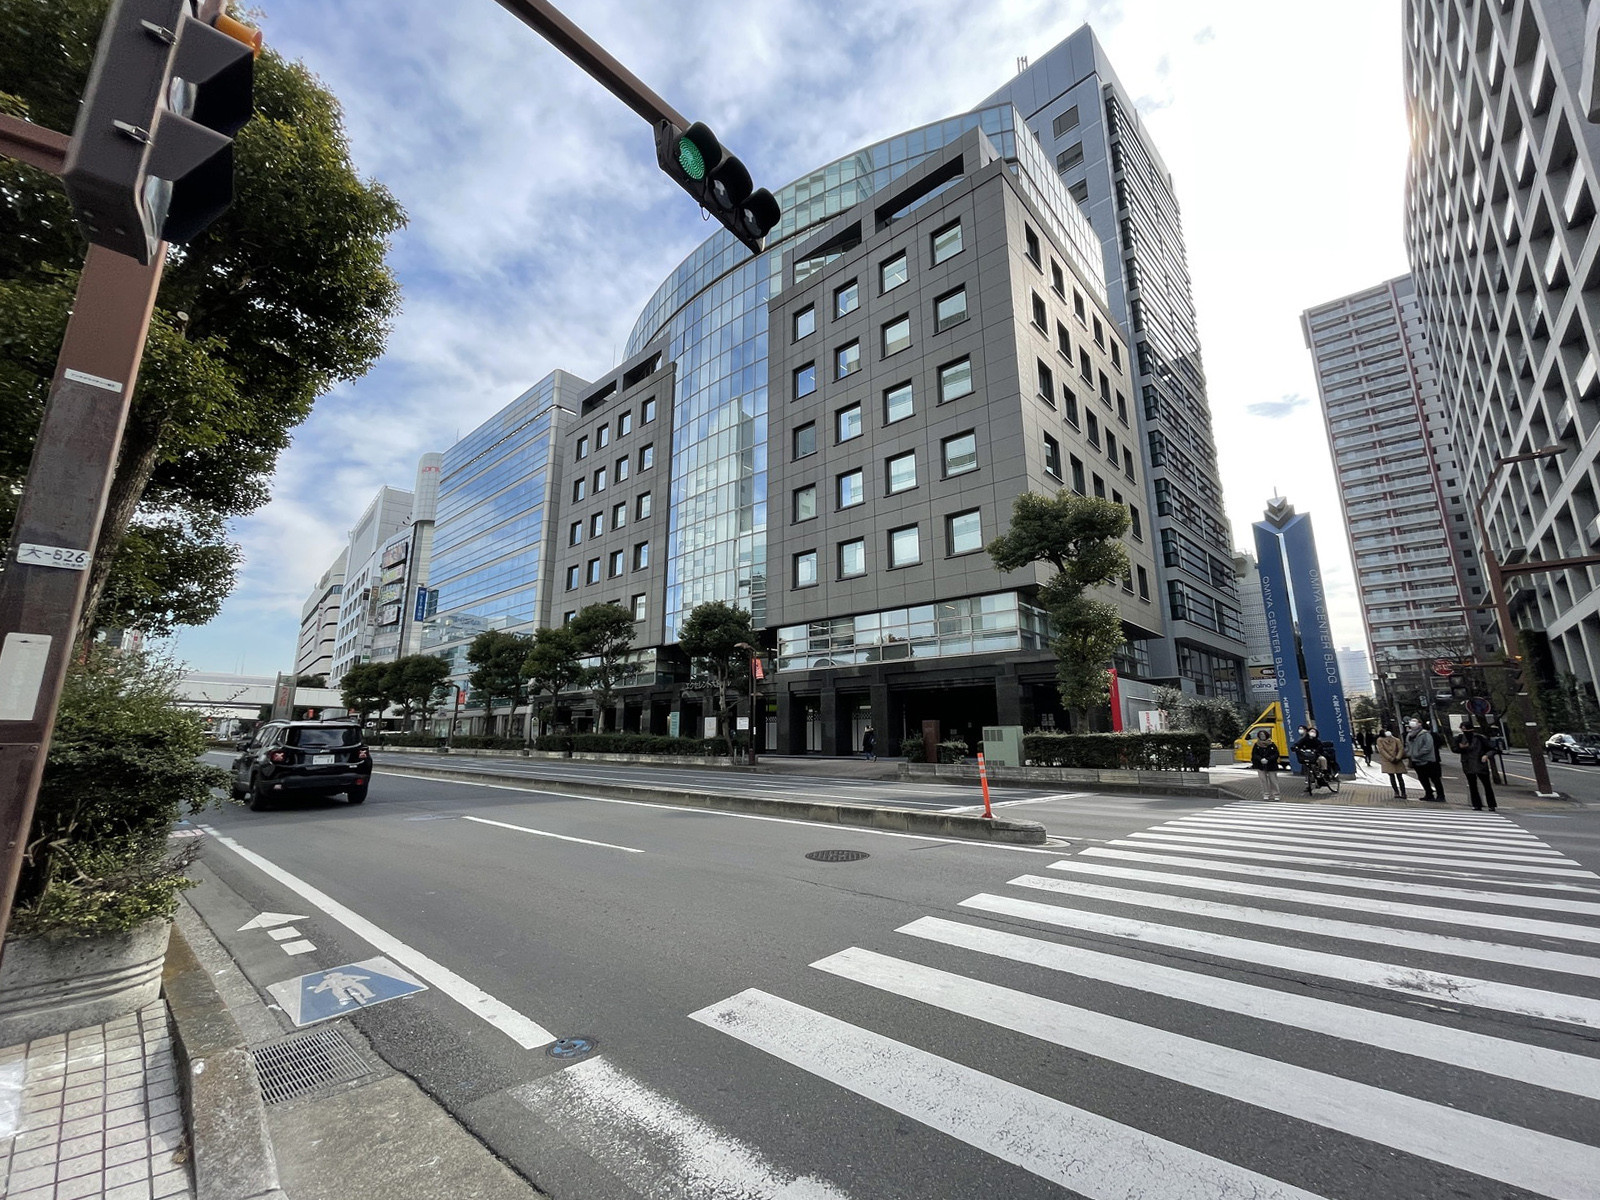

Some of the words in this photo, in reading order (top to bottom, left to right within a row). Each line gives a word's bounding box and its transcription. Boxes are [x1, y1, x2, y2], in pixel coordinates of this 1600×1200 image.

[1262, 576, 1273, 608] OMIYA
[1308, 569, 1322, 603] OMIYA
[1315, 606, 1332, 650] CENTER
[1267, 611, 1281, 653] CENTER
[1282, 696, 1295, 742] 大宮センタービル
[1332, 694, 1346, 742] 大宮センタービル
